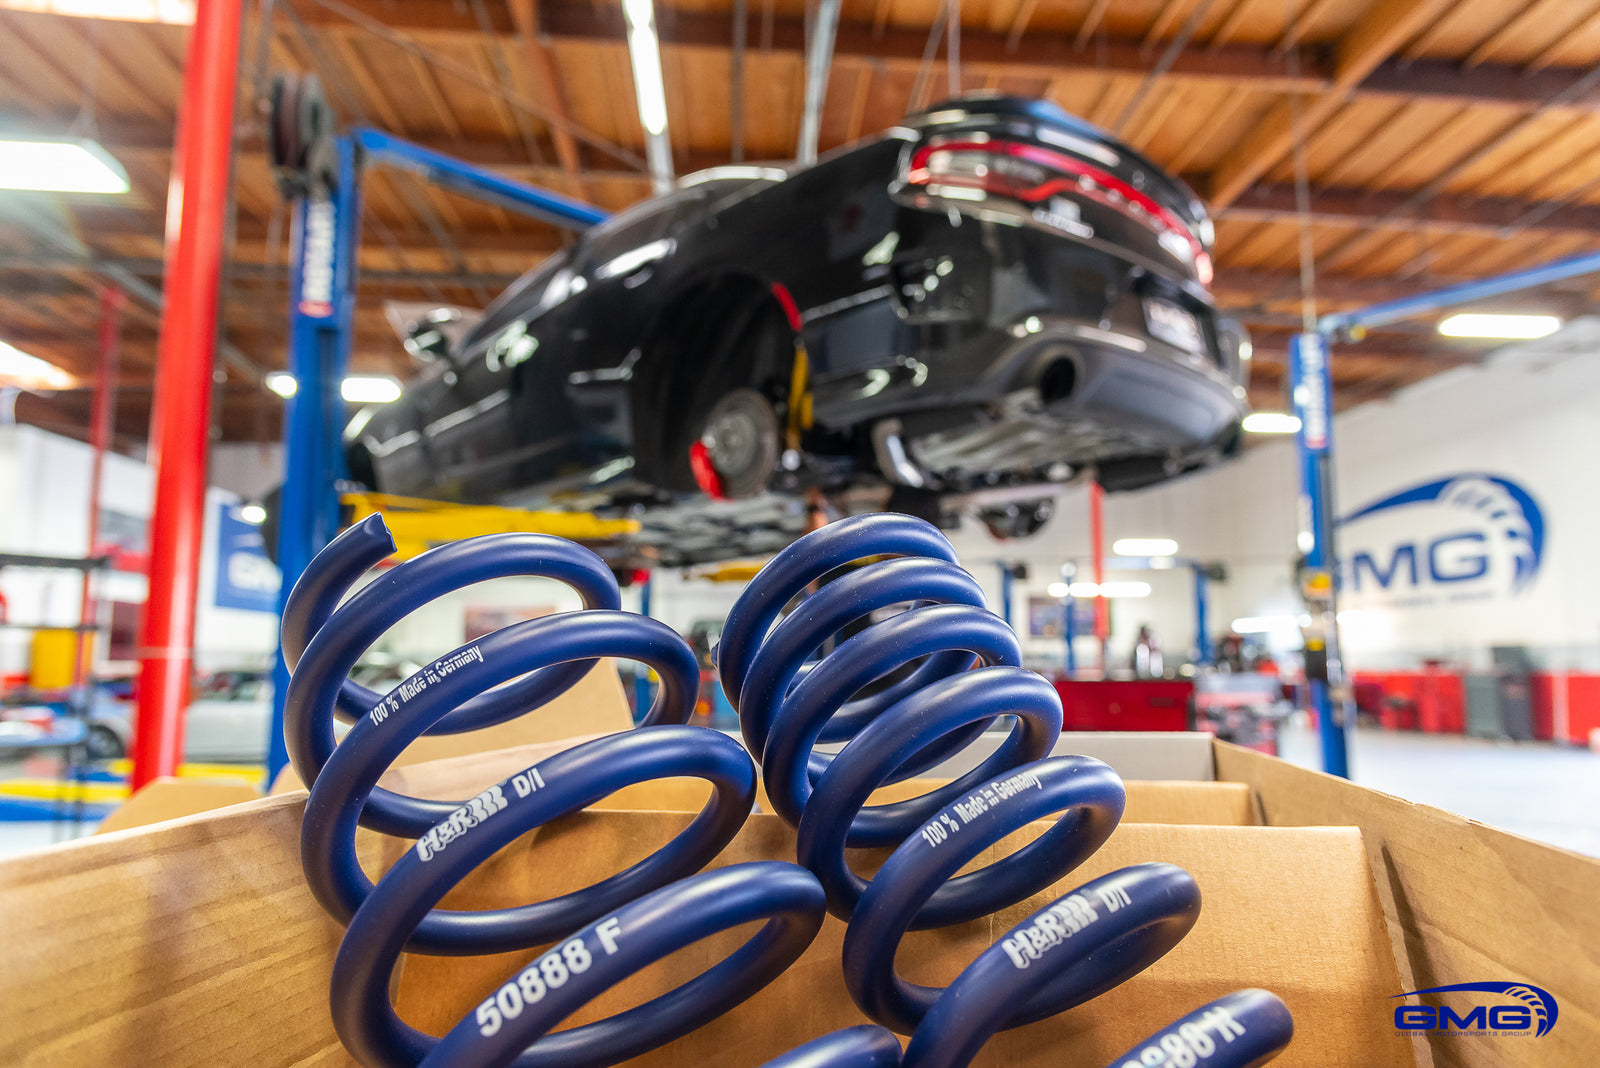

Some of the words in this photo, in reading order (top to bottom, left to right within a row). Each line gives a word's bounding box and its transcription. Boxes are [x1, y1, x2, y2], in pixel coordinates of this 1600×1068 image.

[1336, 531, 1490, 593] MG
[369, 702, 389, 726] 100
[386, 695, 399, 712] %
[399, 676, 427, 702] Made
[424, 670, 438, 685] in
[435, 645, 484, 677] Germany
[512, 767, 545, 798] D/I
[921, 821, 948, 847] 100
[940, 813, 959, 832] %
[953, 796, 988, 824] Made
[991, 772, 1042, 800] Germany
[476, 938, 592, 1037] 50888
[595, 917, 621, 955] F
